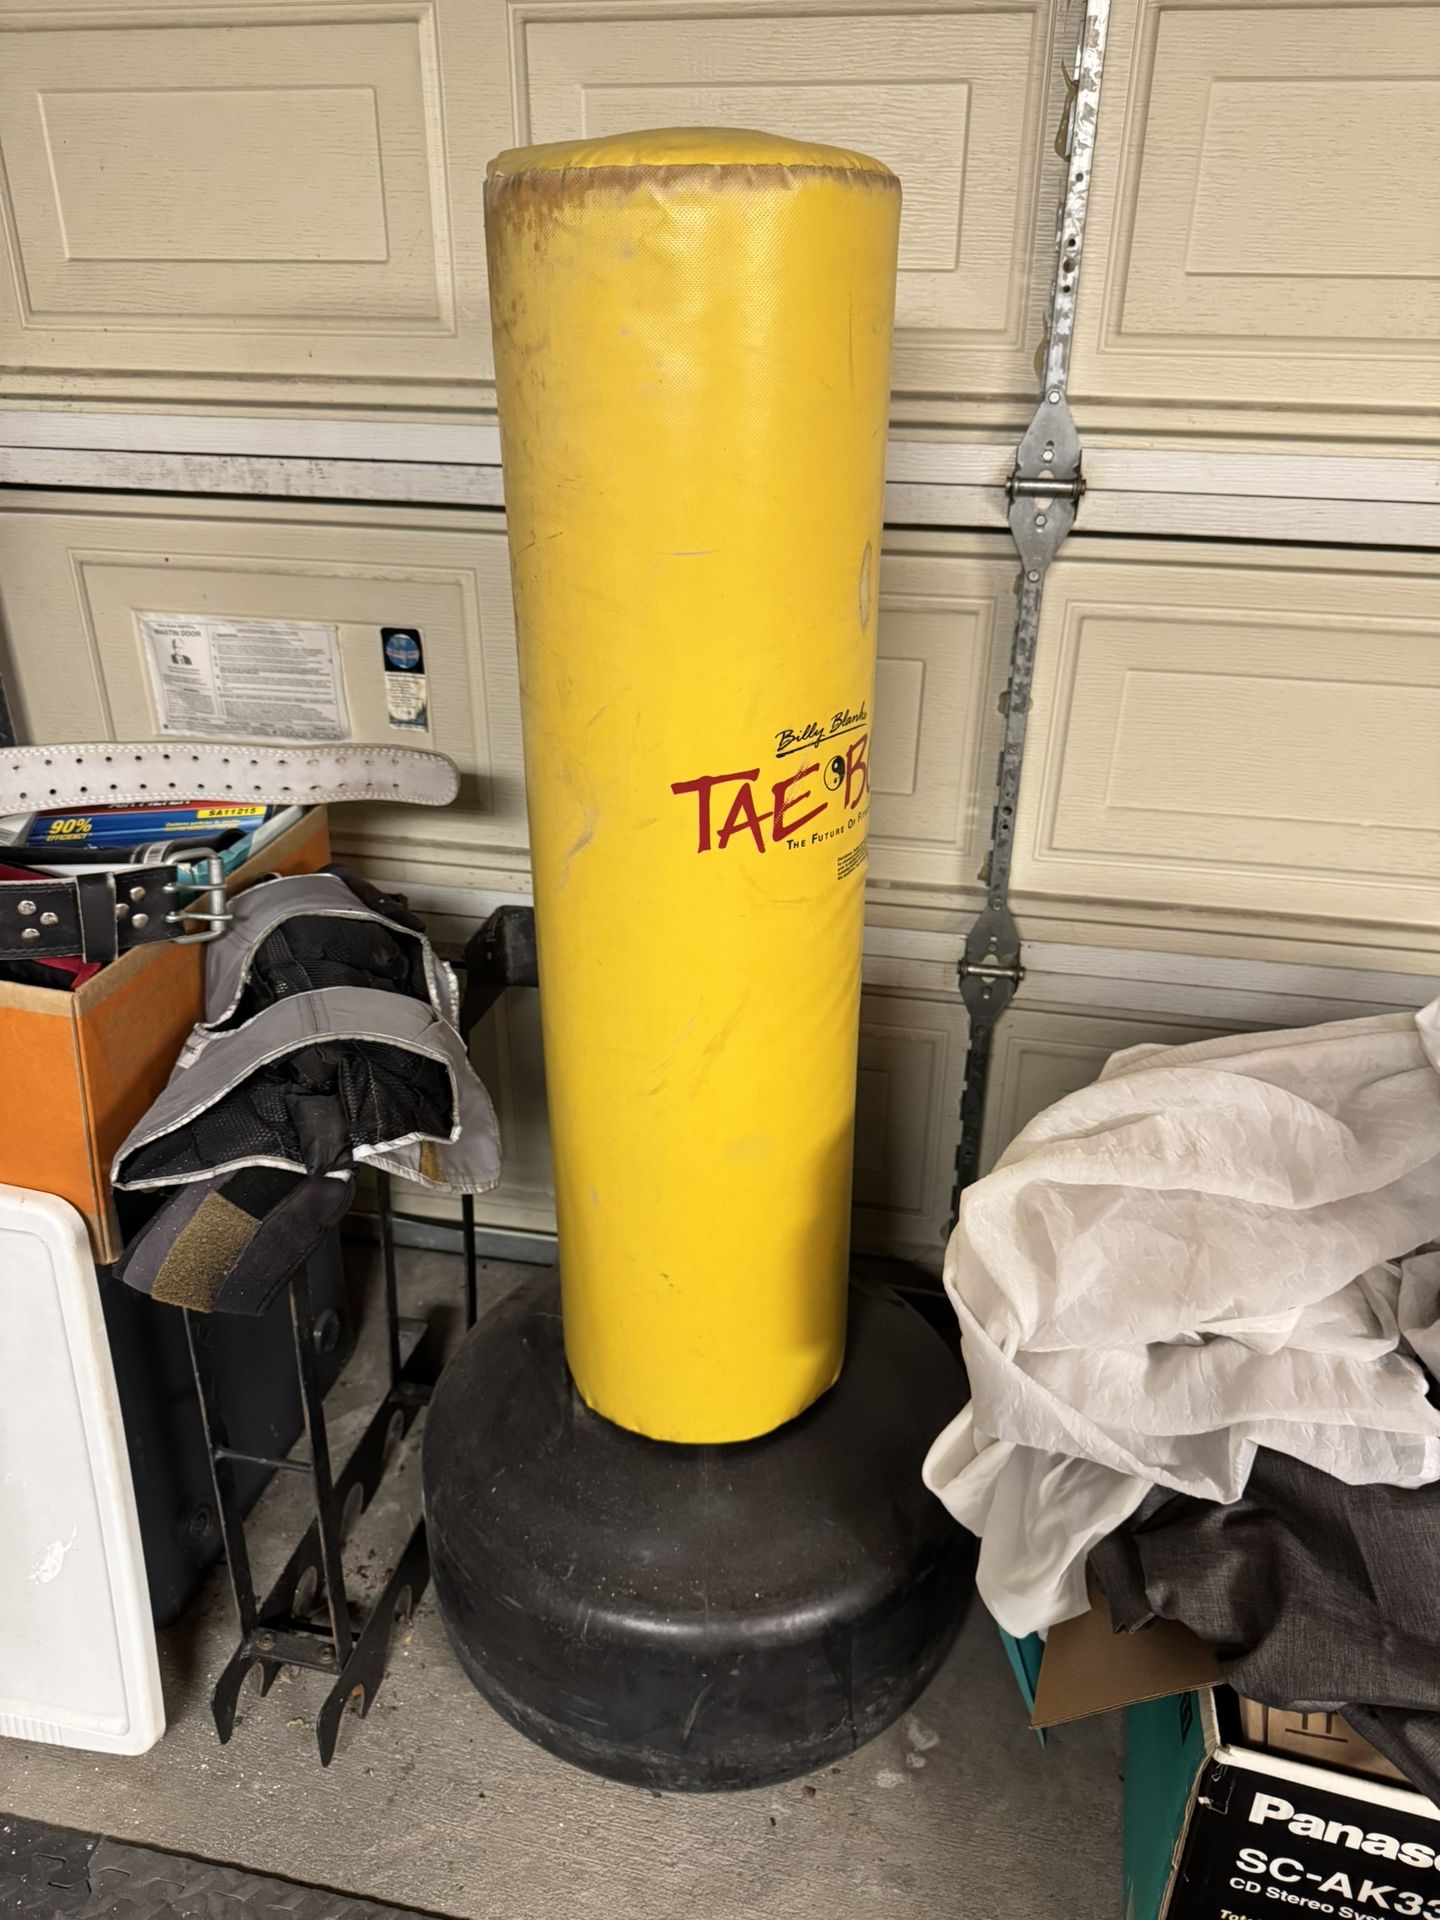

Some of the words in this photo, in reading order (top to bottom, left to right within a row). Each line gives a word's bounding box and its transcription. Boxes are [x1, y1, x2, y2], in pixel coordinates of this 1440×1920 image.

[775, 723, 825, 752] Billy
[671, 763, 829, 854] TAE
[844, 733, 870, 810] B
[49, 818, 92, 834] 90%
[209, 807, 256, 817] SA11215
[786, 839, 806, 850] THE
[811, 825, 845, 845] FUTURE
[1248, 1792, 1440, 1872] Panas
[1229, 1877, 1262, 1894] CD
[1265, 1886, 1334, 1913] Stereo
